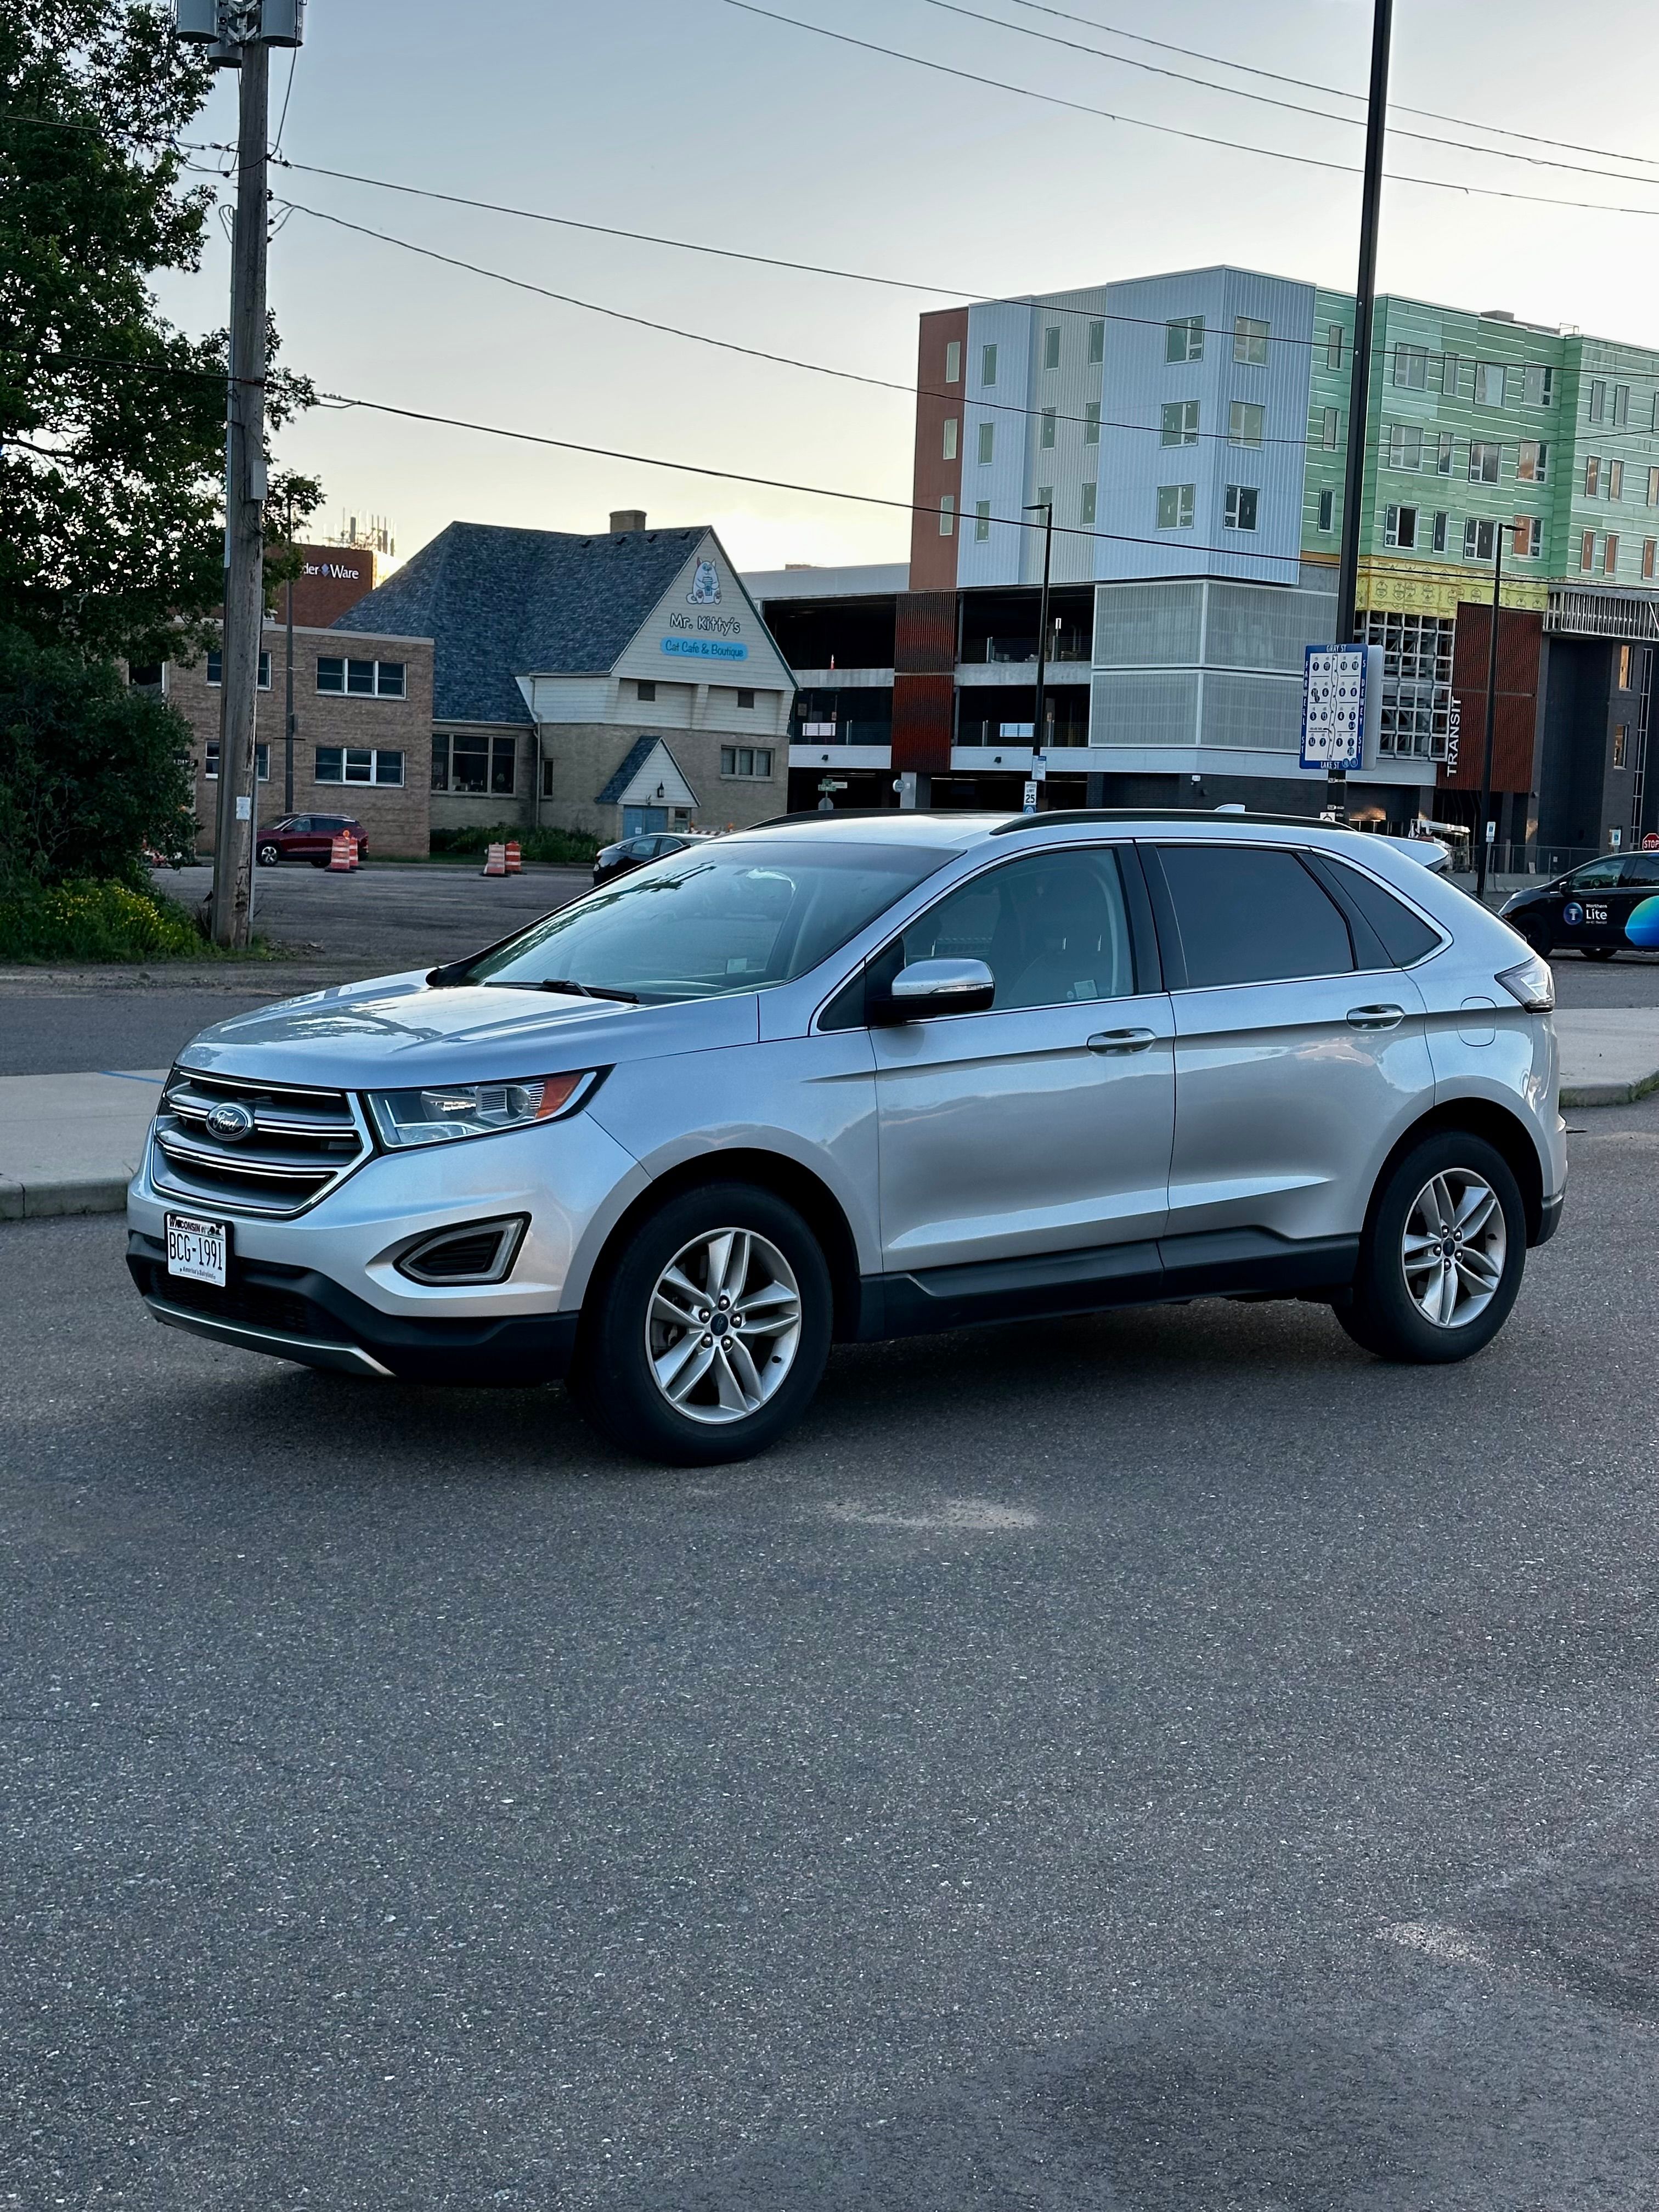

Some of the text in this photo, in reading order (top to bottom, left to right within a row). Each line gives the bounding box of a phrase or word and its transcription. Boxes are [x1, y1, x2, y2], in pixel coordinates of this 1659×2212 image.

[302, 562, 359, 579] der Ware
[670, 613, 741, 636] Mr. Kitty's
[665, 640, 679, 651] Cat
[701, 644, 710, 654] &
[711, 644, 744, 658] Boutique
[1363, 659, 1367, 668] S
[1447, 696, 1462, 777] TRANSIT
[1301, 737, 1305, 754] ST
[1358, 737, 1362, 754] ST
[1026, 794, 1035, 803] 25
[1644, 840, 1659, 849] STOP
[212, 1110, 239, 1131] Ford
[169, 1232, 223, 1271] BCG-1991
